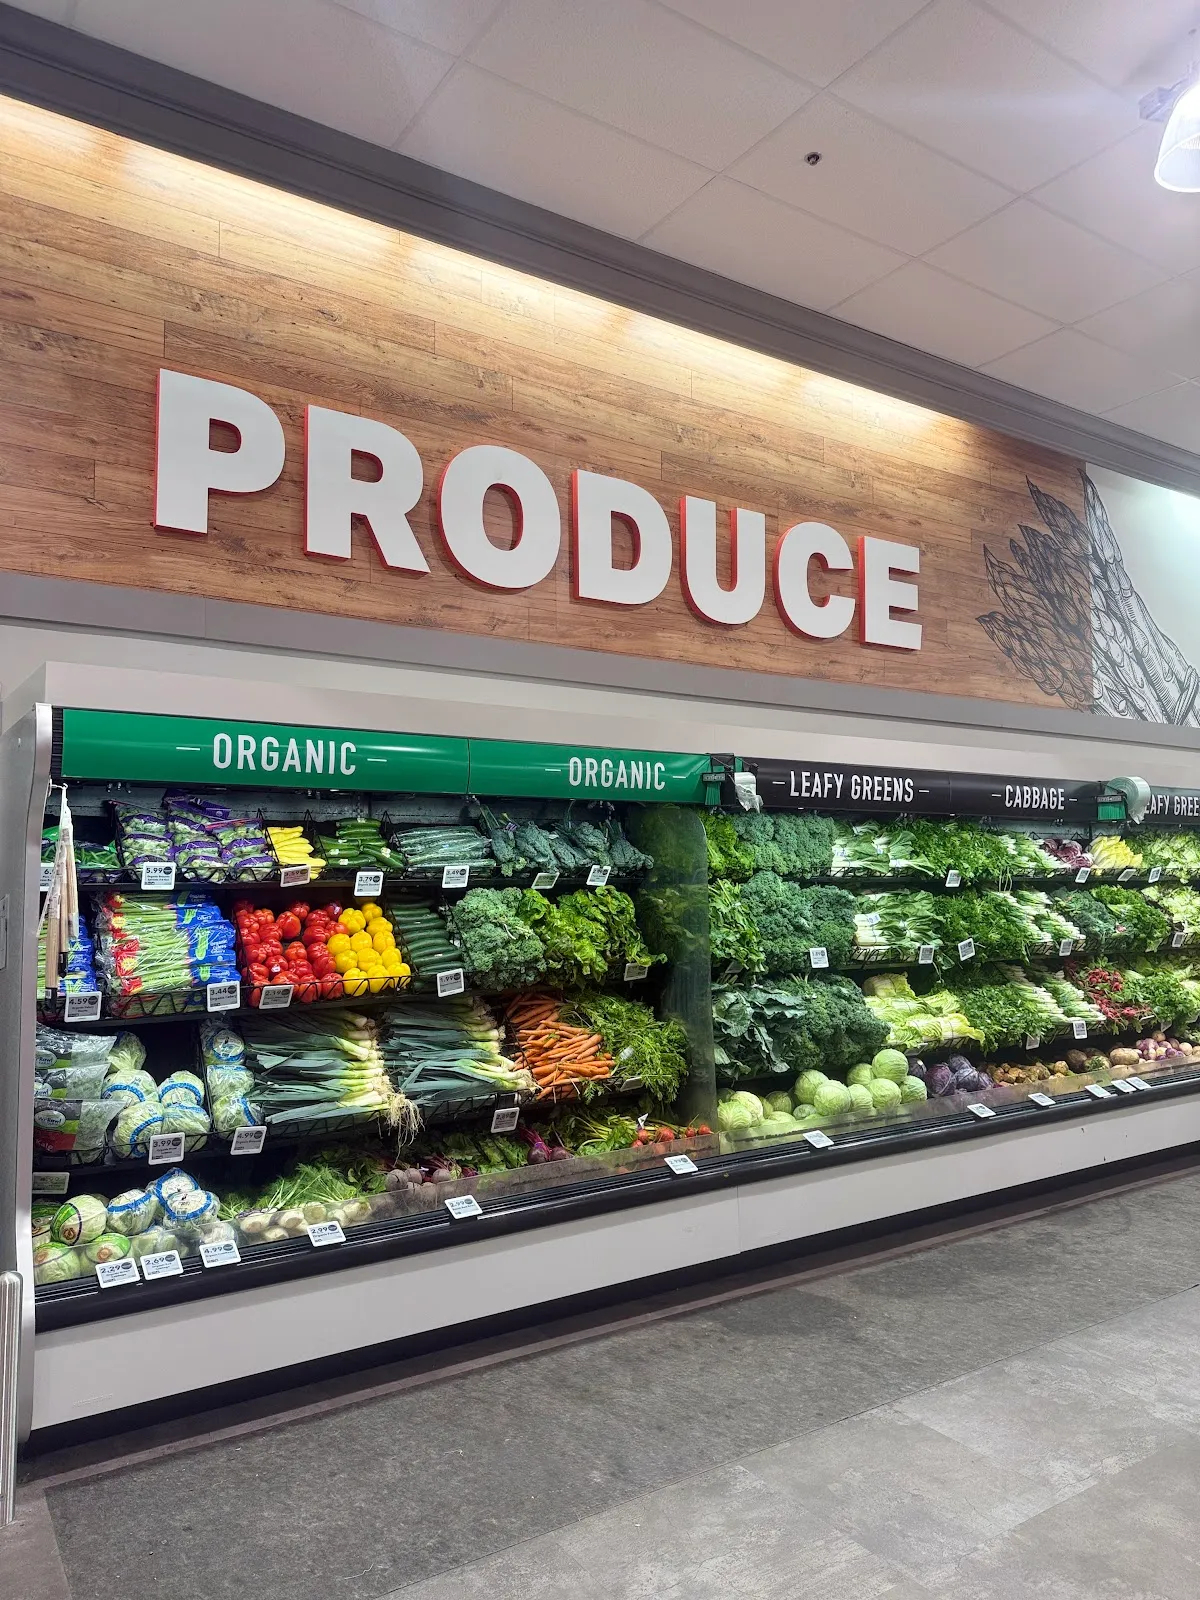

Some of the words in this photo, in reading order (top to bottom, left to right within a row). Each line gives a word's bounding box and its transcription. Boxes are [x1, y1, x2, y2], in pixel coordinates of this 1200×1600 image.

[154, 368, 922, 650] PRODUCE
[212, 733, 357, 776] ORGANIC
[569, 756, 666, 791] ORGANIC
[789, 770, 844, 799] LEAFY
[850, 774, 914, 803] GREENS
[1005, 784, 1065, 810] CABBAGE
[1173, 795, 1200, 817] GREE
[210, 987, 227, 995] 3.44
[69, 997, 88, 1005] 4.59
[153, 1140, 171, 1148] 3.99
[311, 1226, 328, 1234] 2.99
[204, 1246, 223, 1254] 4.99
[145, 1256, 165, 1265] 2.69
[100, 1264, 121, 1274] 2.29
